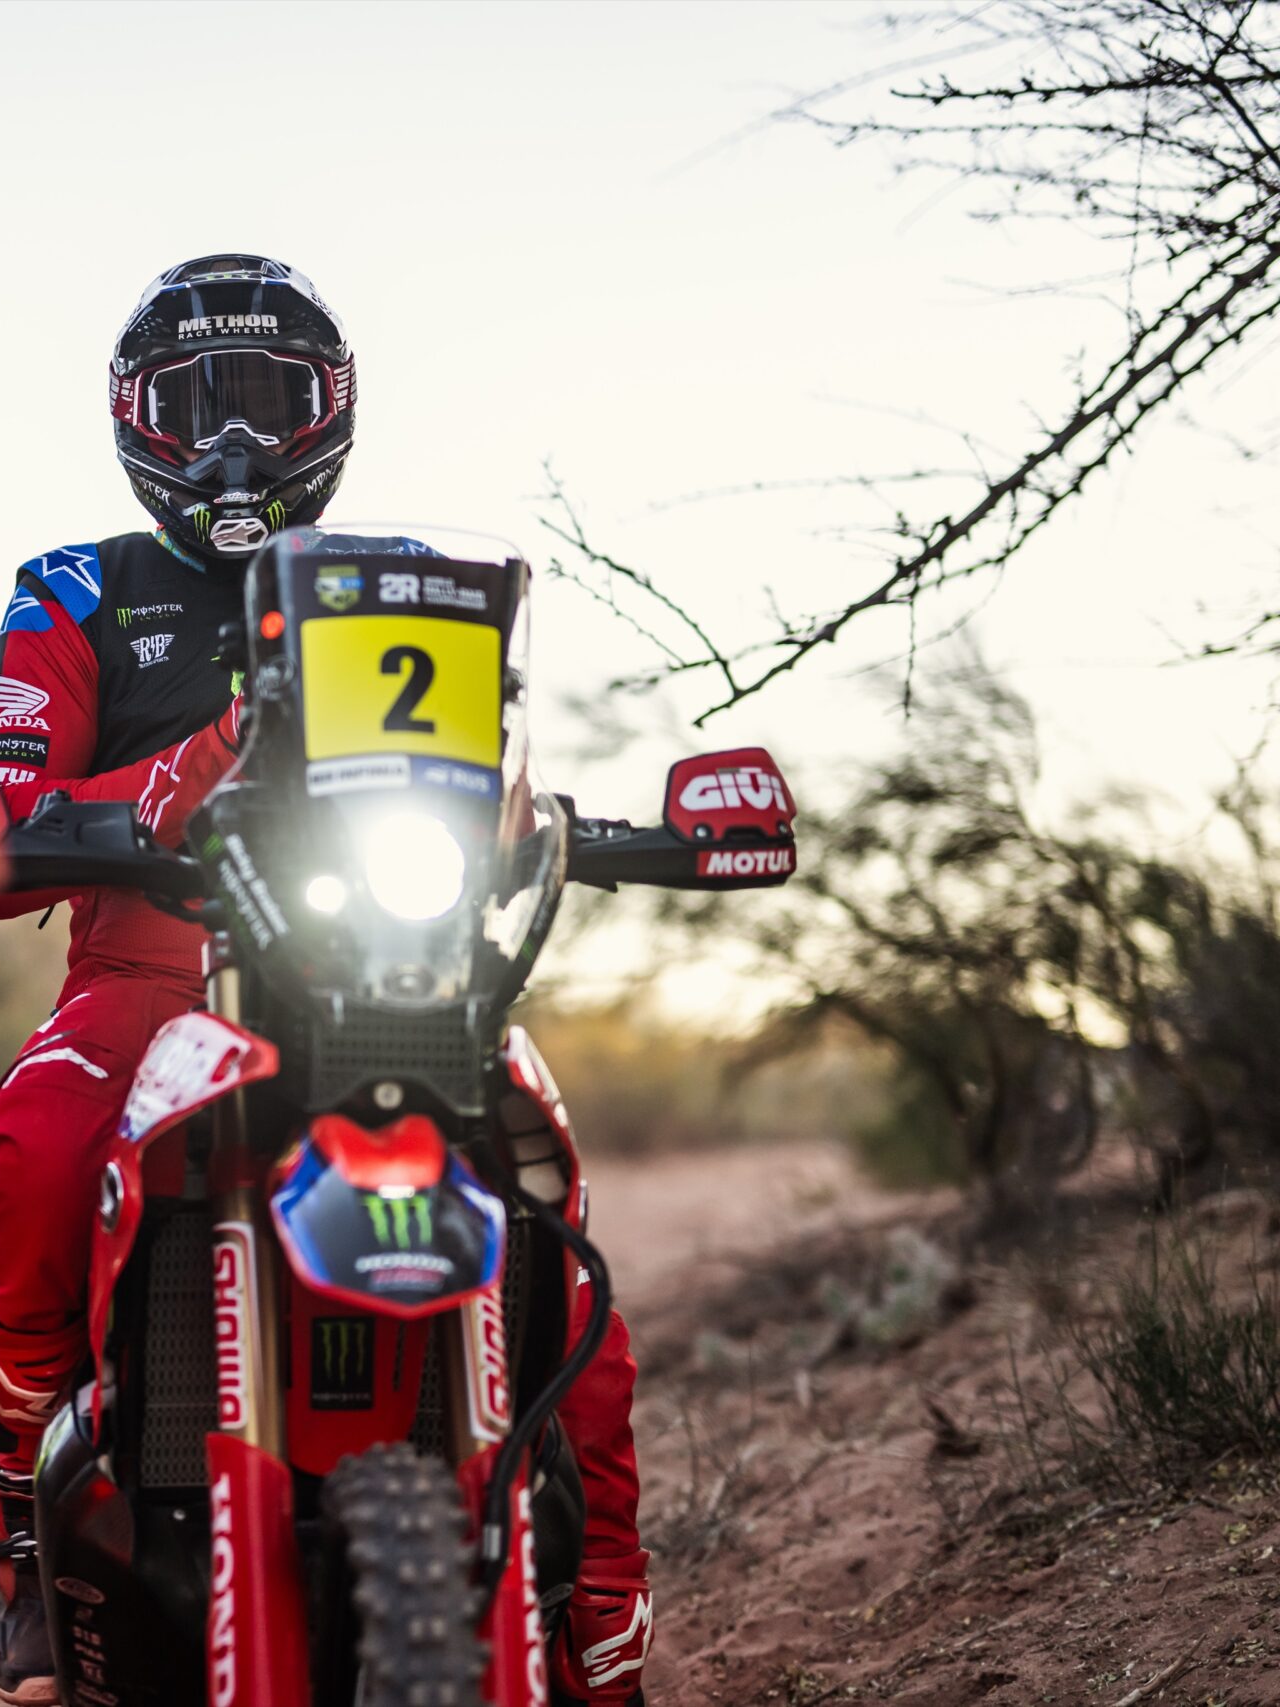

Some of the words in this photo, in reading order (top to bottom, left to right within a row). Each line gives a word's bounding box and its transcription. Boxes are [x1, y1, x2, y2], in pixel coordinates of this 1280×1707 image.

[178, 314, 278, 333] METHOD
[178, 329, 212, 340] RACE
[221, 327, 279, 335] WHEELS
[131, 604, 184, 616] MONSTER
[379, 645, 436, 735] 2
[678, 772, 788, 812] GIVI
[706, 851, 792, 875] MOTUL
